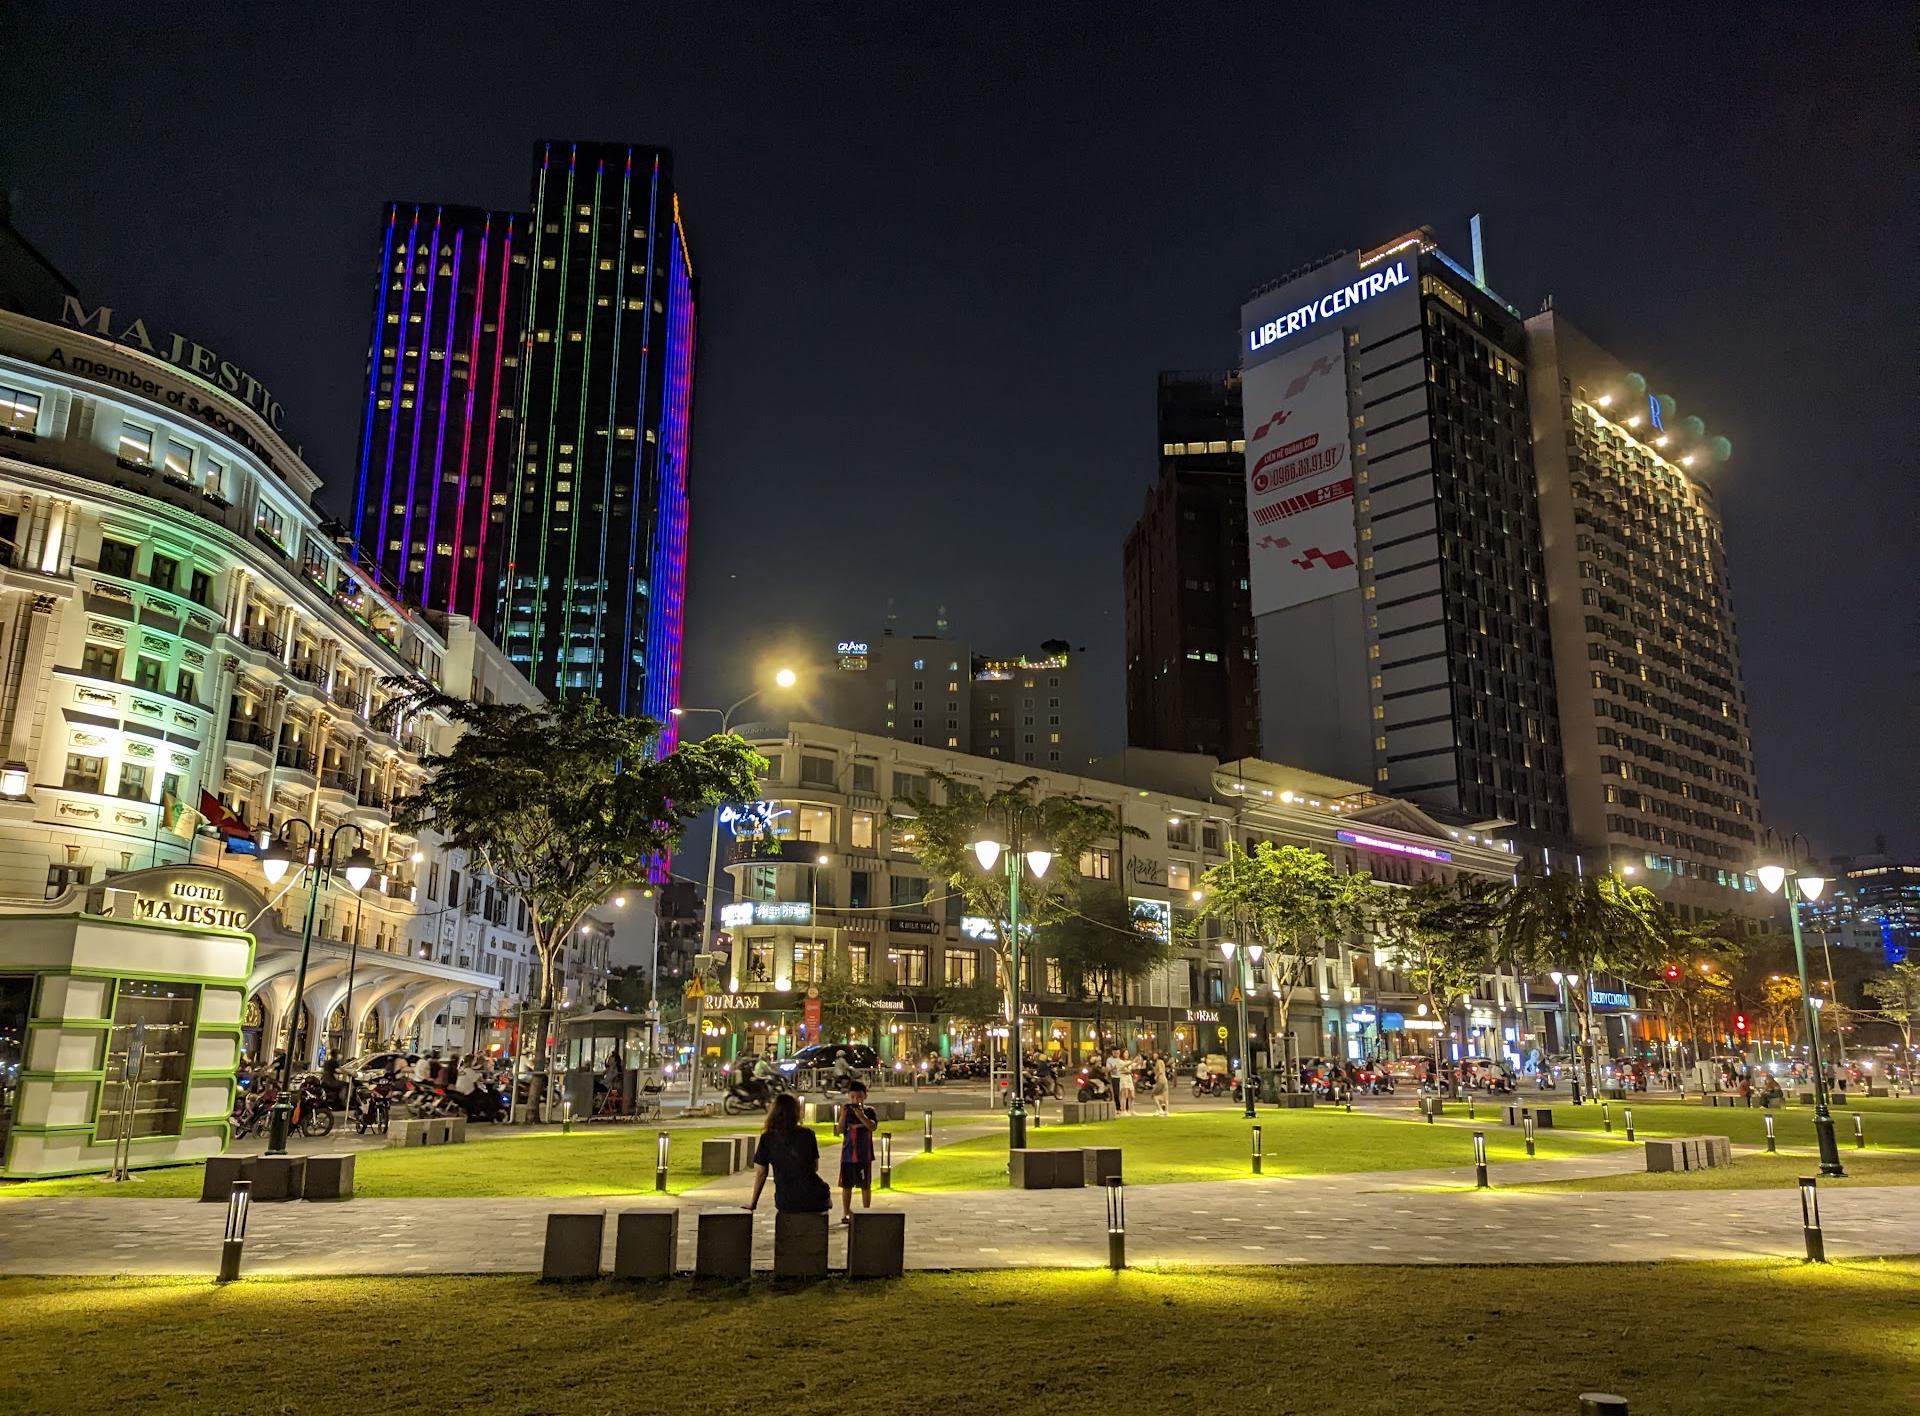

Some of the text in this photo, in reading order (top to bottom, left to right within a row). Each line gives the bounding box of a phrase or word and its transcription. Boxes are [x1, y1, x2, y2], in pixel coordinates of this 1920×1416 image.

[1250, 262, 1410, 351] LIBERTY CENTRAL
[46, 347, 187, 408] A member of
[57, 295, 286, 432] MAJESTIC
[837, 640, 868, 652] GRAND
[173, 883, 225, 902] HOTEL
[137, 898, 248, 930] MAJESTIC
[704, 994, 760, 1009] RUNAM
